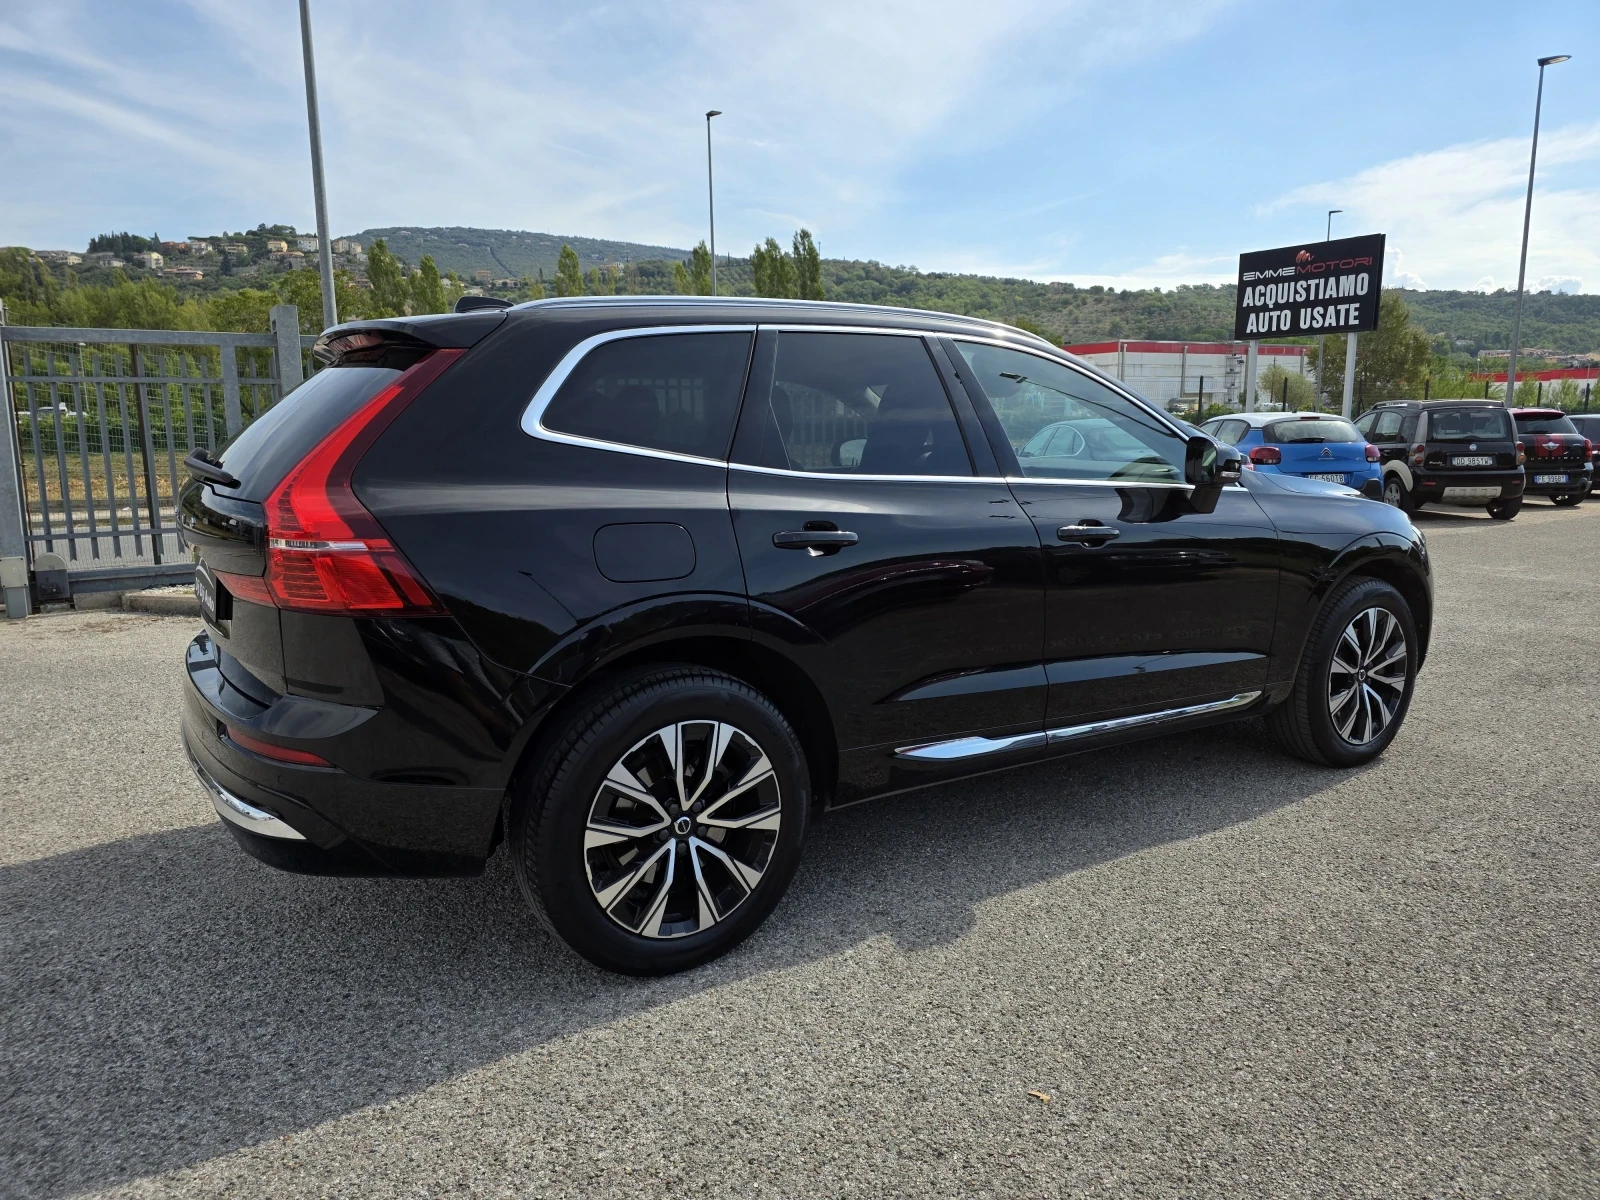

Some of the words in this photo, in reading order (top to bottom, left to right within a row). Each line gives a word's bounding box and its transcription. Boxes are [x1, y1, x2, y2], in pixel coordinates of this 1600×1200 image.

[1243, 272, 1369, 308] ACQUISTIAMO
[1246, 309, 1291, 334] AUTO
[1299, 302, 1360, 330] USATE
